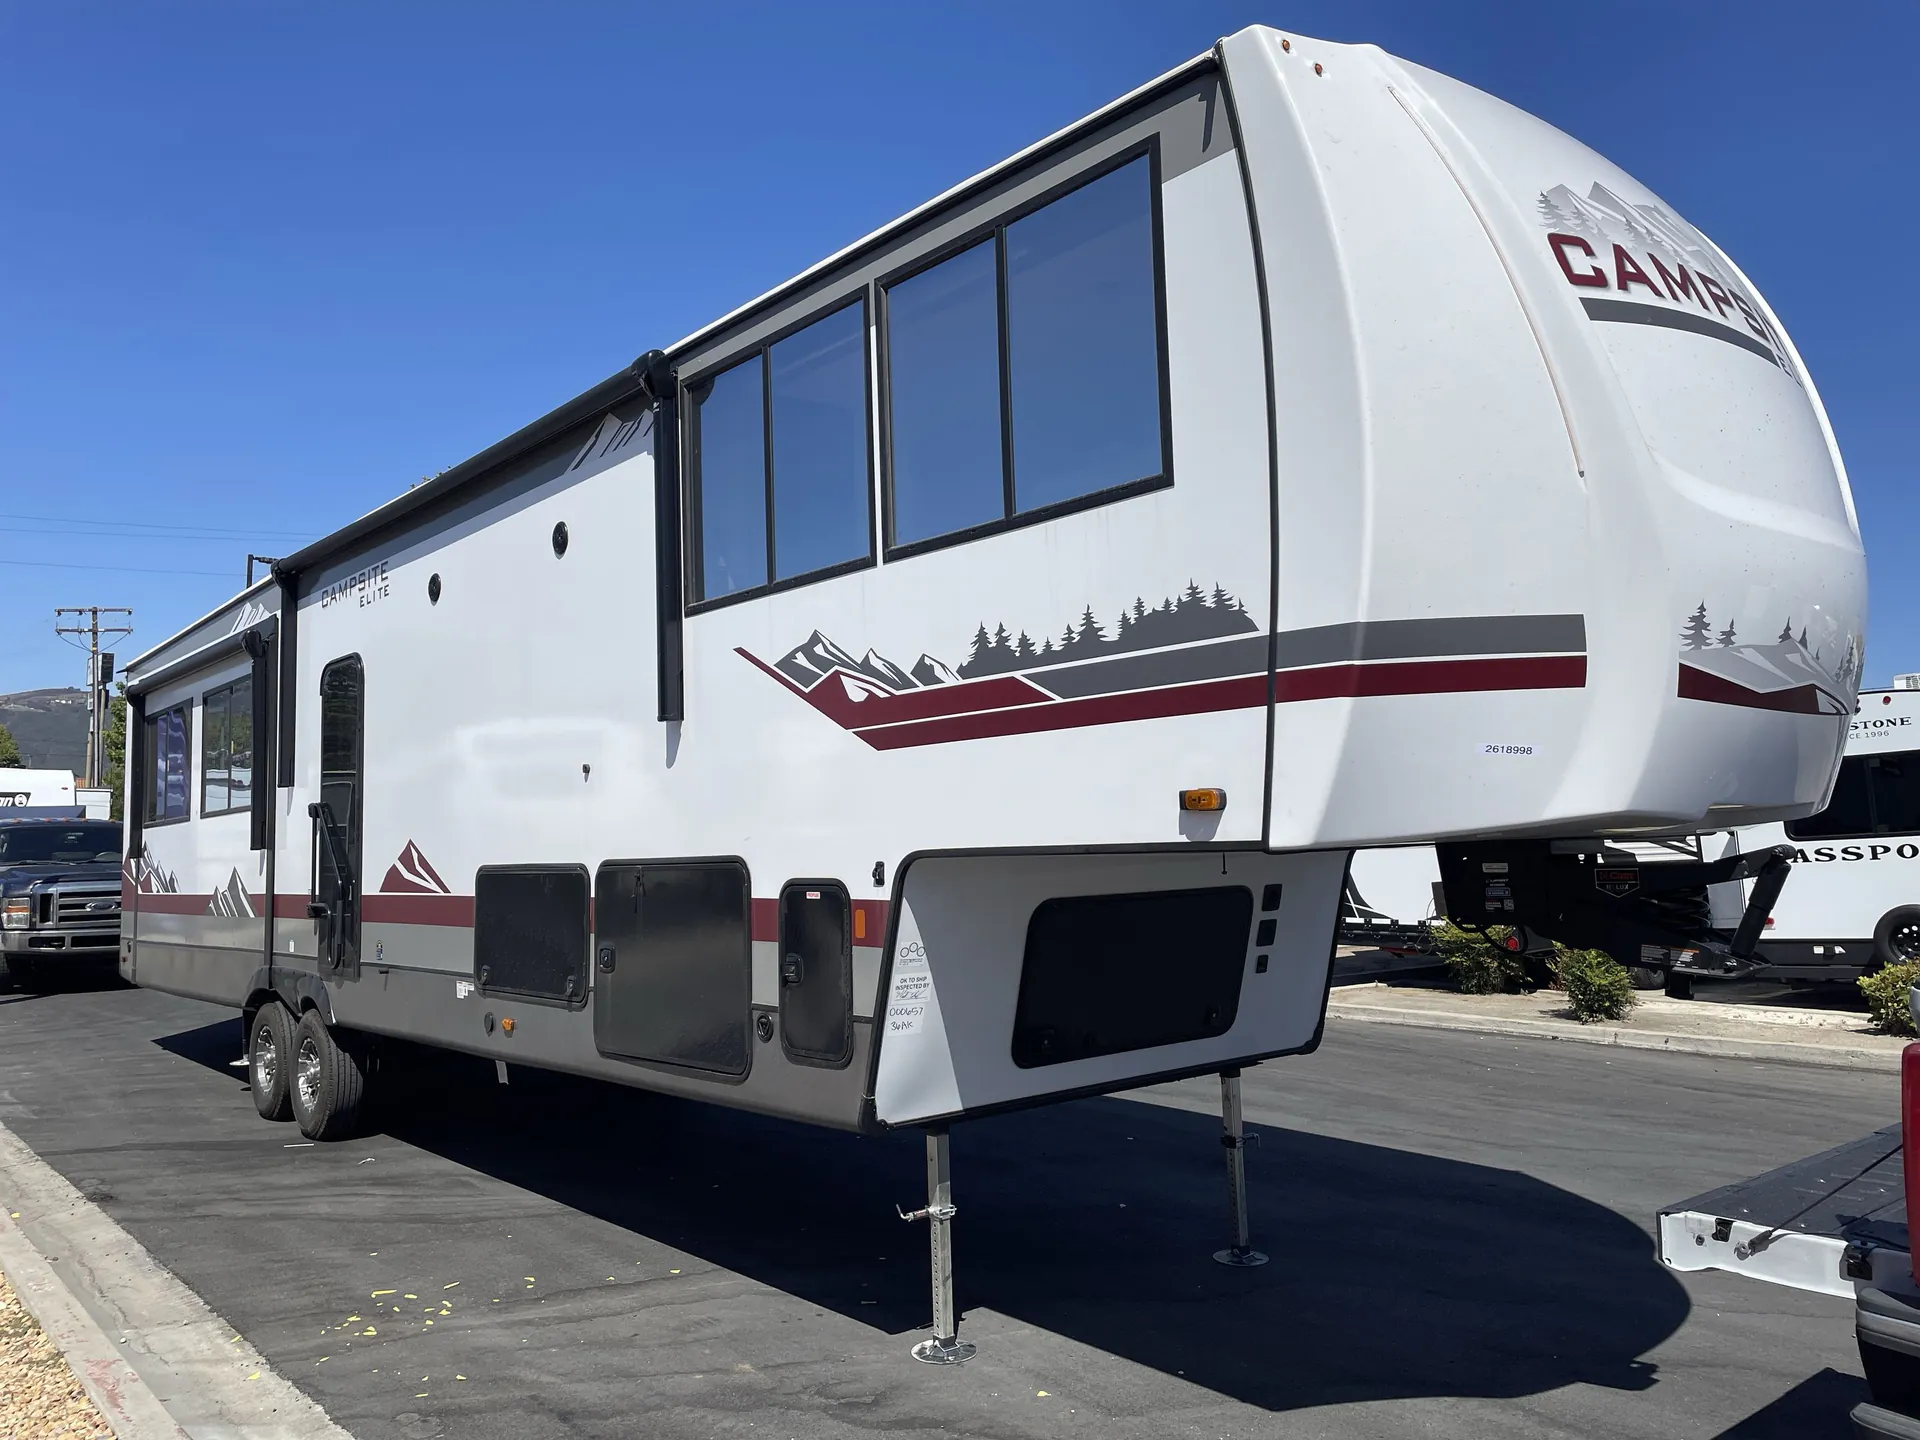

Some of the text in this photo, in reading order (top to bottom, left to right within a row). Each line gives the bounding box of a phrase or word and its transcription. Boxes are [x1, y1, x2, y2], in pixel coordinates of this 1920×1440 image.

[321, 560, 389, 608] CAMPSITE
[359, 584, 390, 608] ELITE
[1849, 716, 1912, 731] STONE
[1848, 730, 1890, 740] CE 1996
[1485, 744, 1533, 755] 2618998
[1791, 843, 1920, 863] ASSPO
